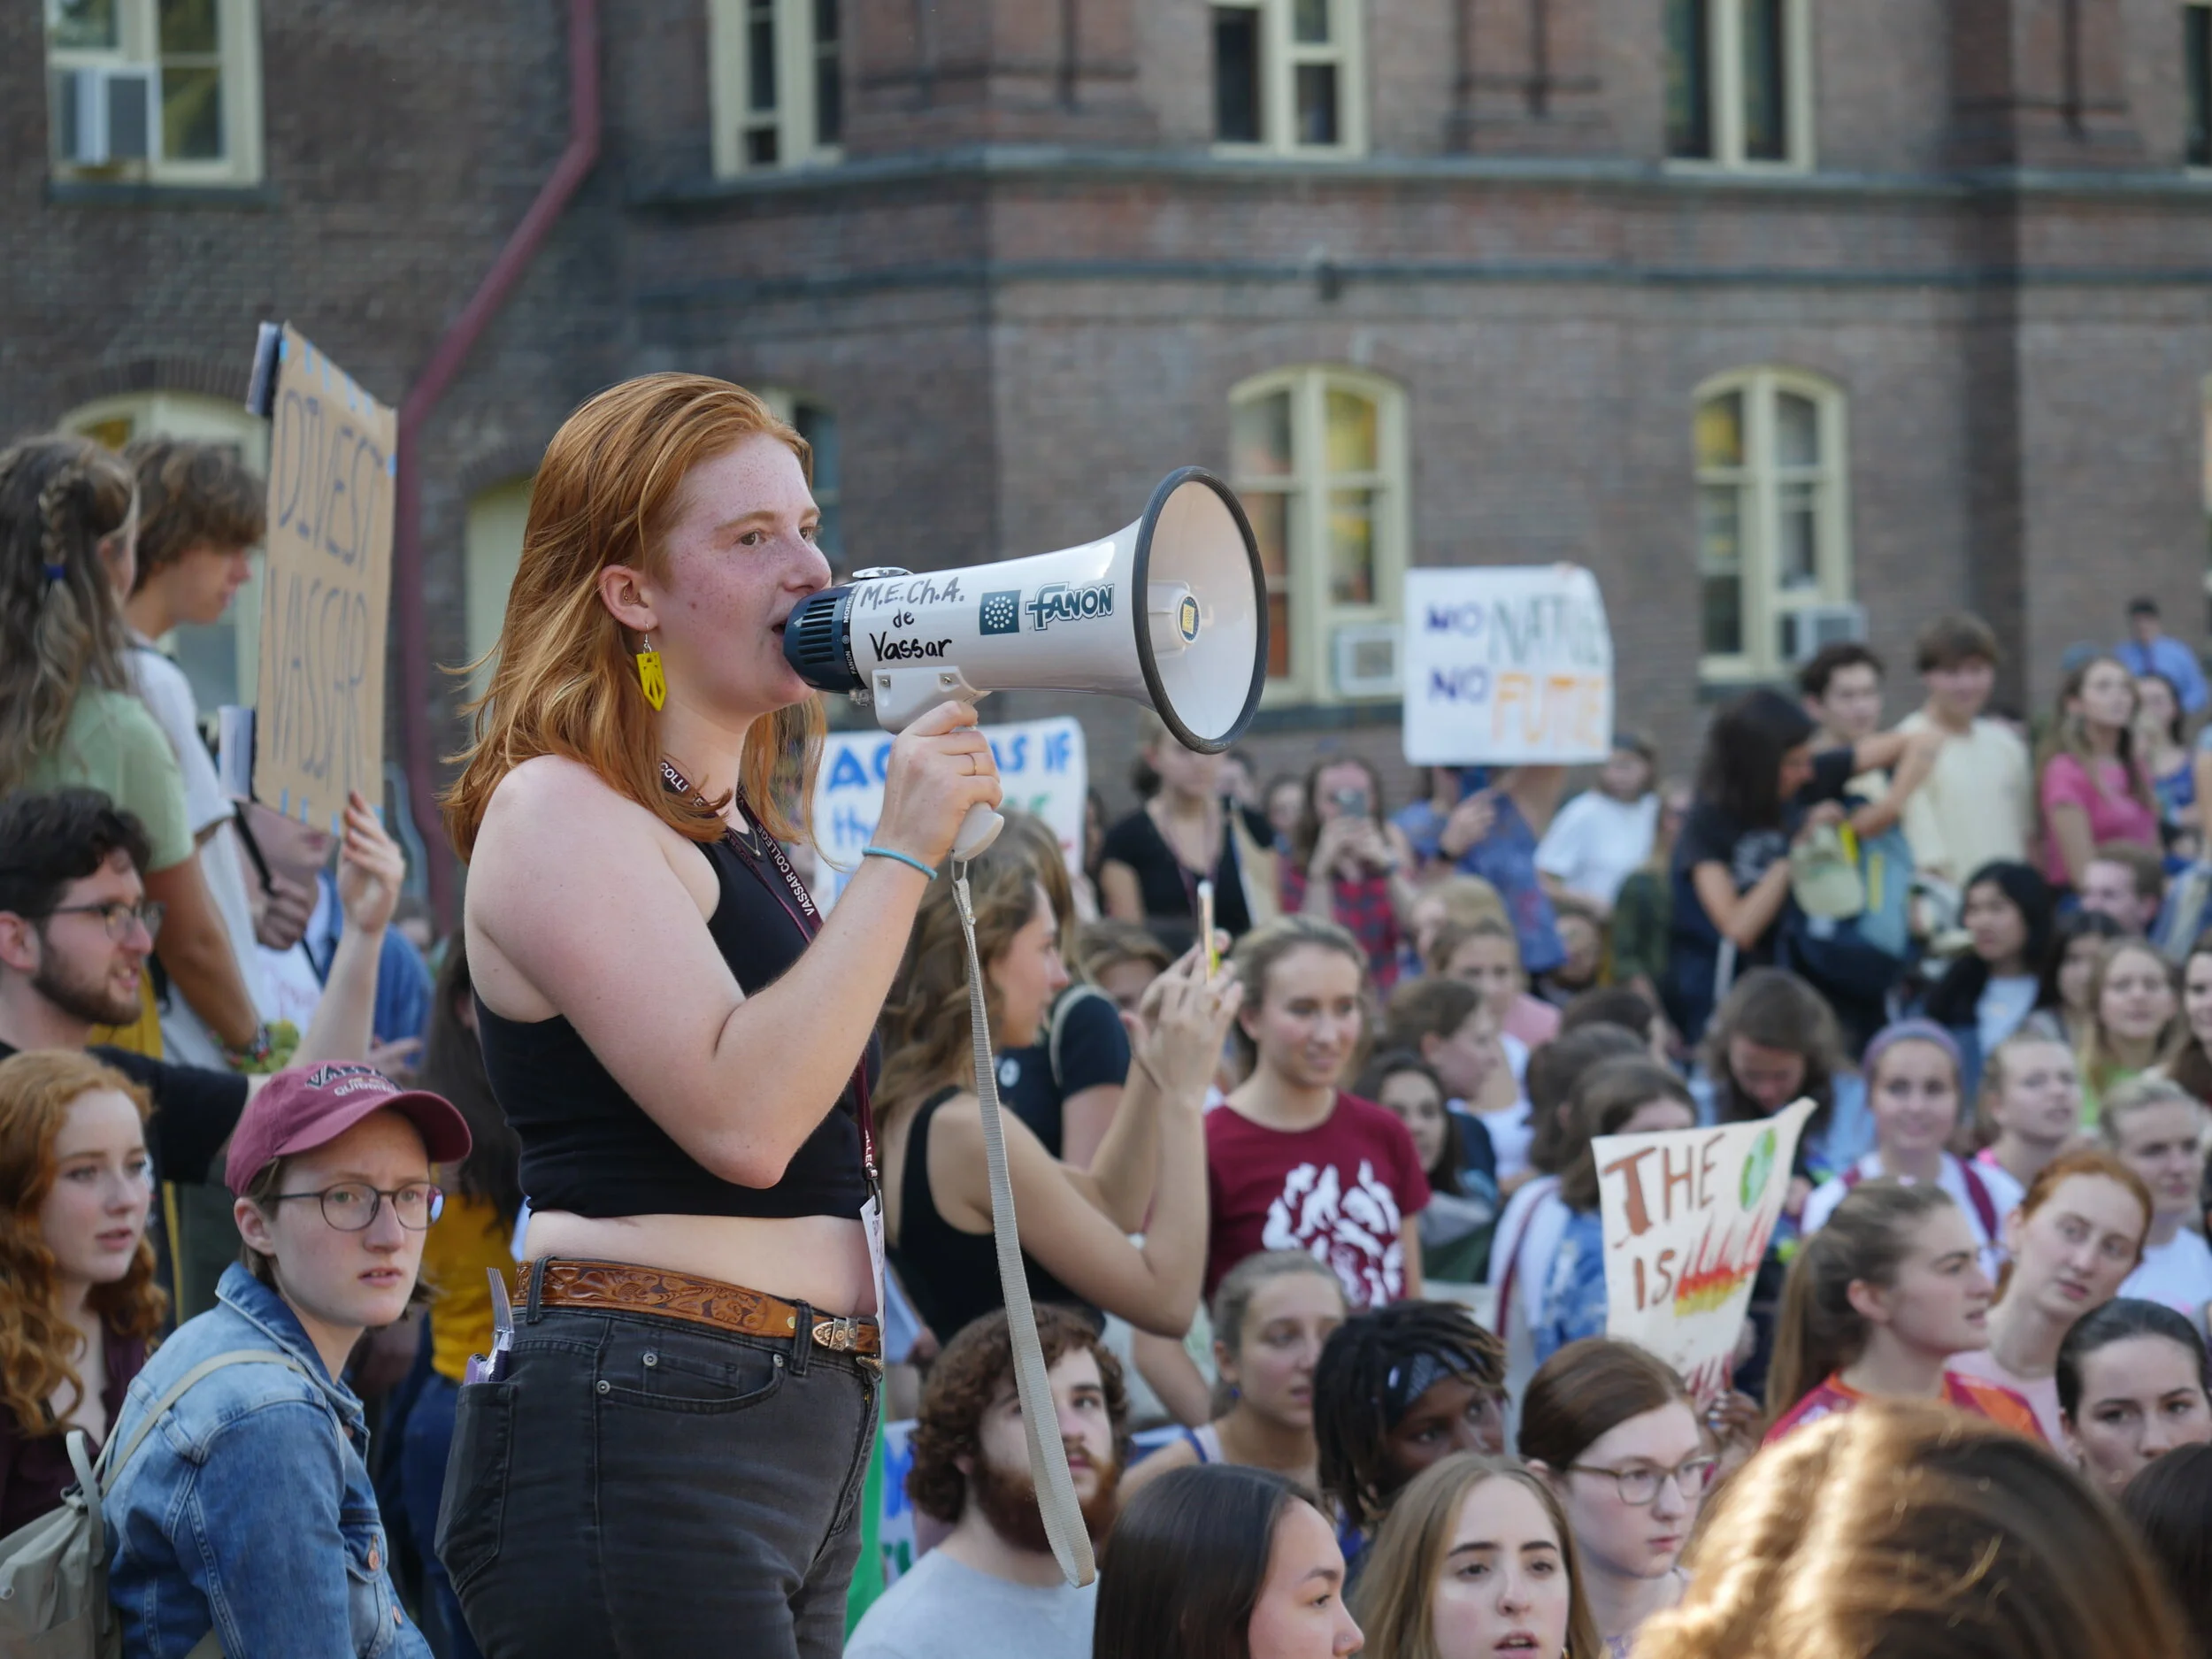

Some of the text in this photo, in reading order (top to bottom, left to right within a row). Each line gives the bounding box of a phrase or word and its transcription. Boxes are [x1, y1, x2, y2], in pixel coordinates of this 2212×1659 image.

[280, 389, 383, 575] DIVEST
[860, 577, 965, 610] M.E.Ch.A.
[892, 609, 915, 628] de
[1424, 601, 1485, 636] NO
[845, 650, 857, 675] FANON
[869, 631, 953, 661] Vassar
[1426, 666, 1491, 704] NO
[827, 741, 891, 792] AC
[1044, 729, 1071, 773] IF
[757, 823, 816, 917] VASSAR COLLEGE
[1601, 1132, 1726, 1238] THE
[1634, 1248, 1677, 1313] IS
